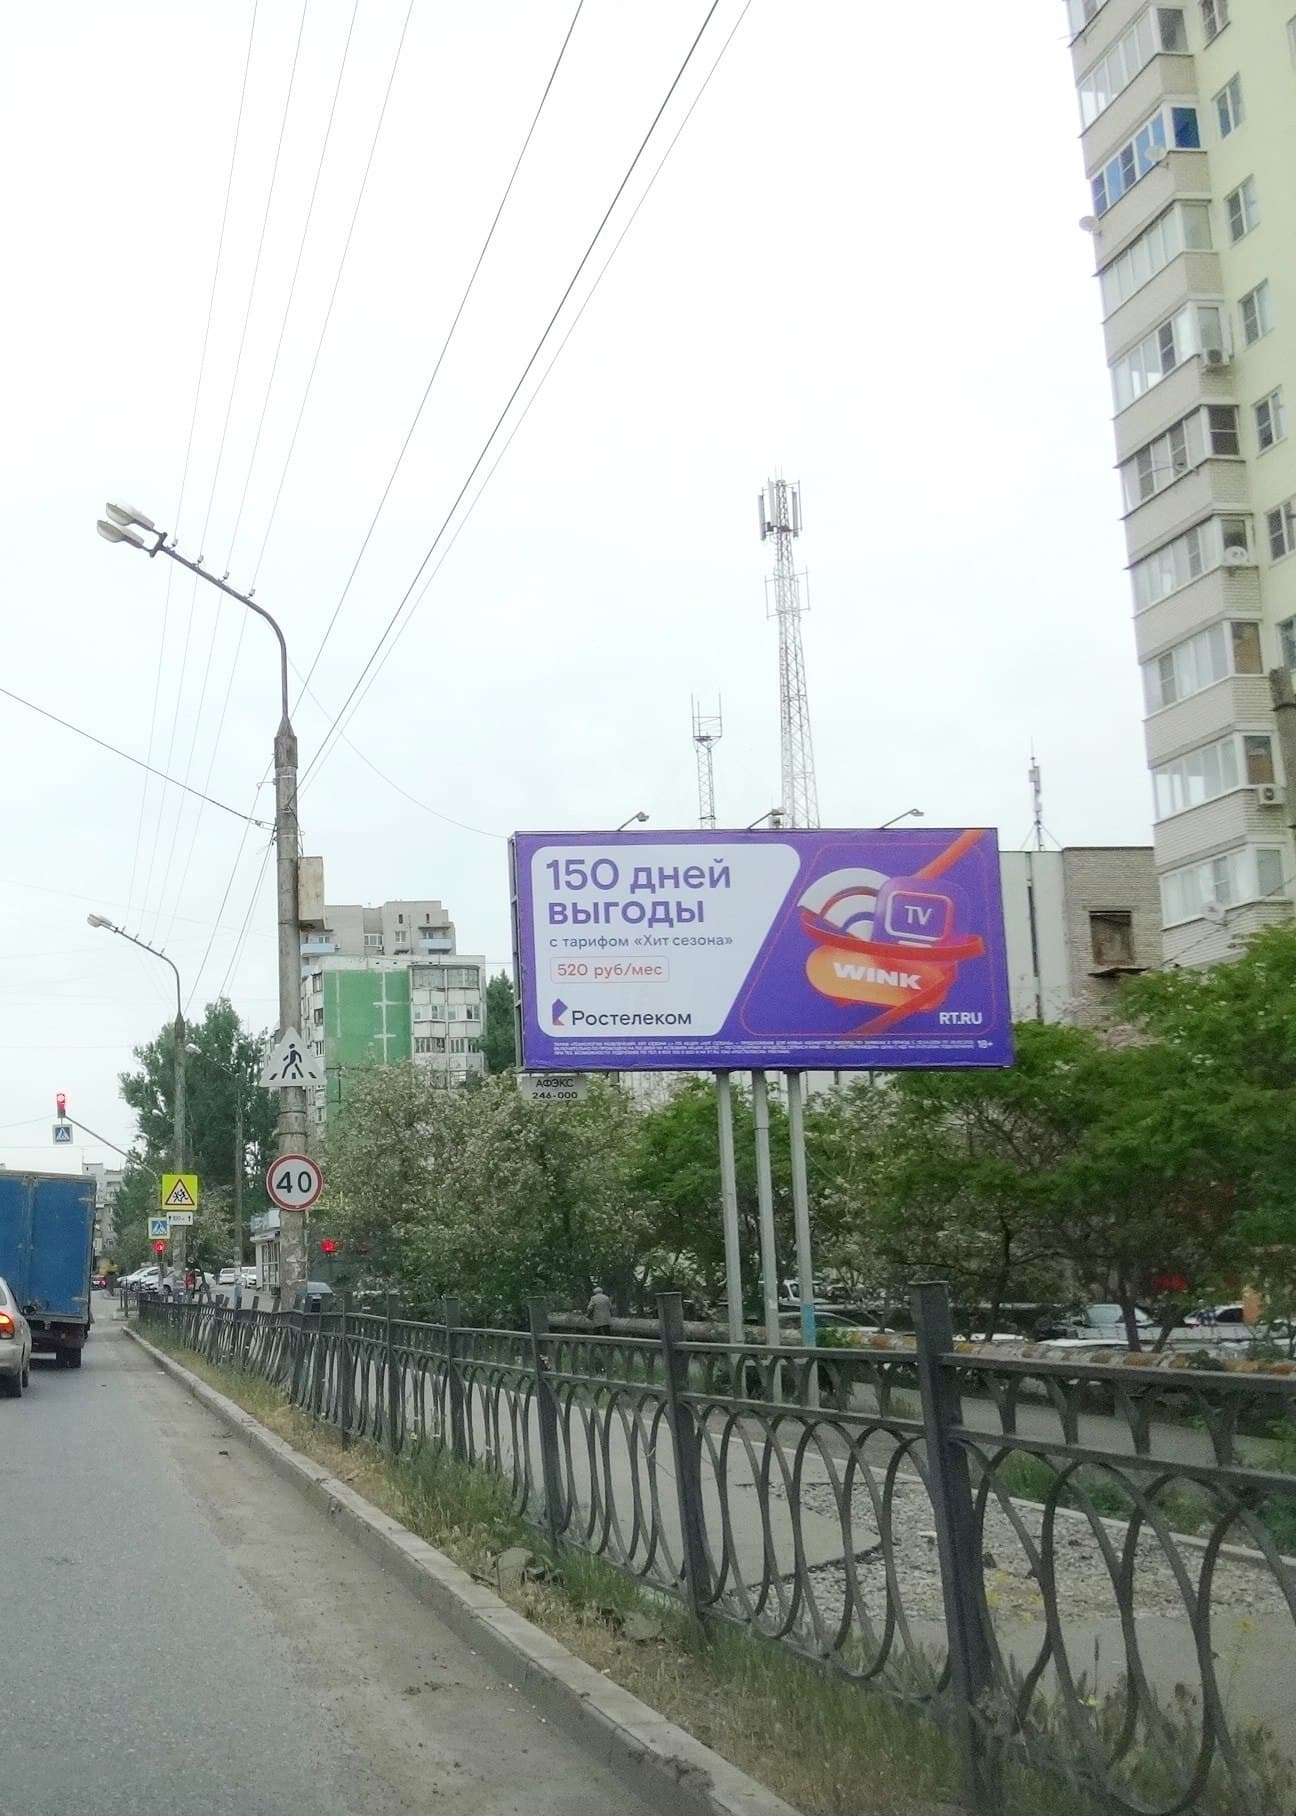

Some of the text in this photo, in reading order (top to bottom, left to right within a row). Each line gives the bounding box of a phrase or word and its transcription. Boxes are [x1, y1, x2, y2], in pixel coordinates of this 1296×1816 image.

[546, 858, 731, 894] 150 дней
[548, 900, 705, 928] выгоды
[904, 905, 933, 925] TV
[549, 935, 733, 950] с тарифом «Хит сезона»
[557, 963, 663, 979] 520 руб/мес
[833, 962, 922, 990] WINK
[572, 1010, 692, 1026] Ростелеком
[939, 1012, 983, 1025] RT.RU
[535, 1078, 575, 1088] АФЭКС
[532, 1091, 578, 1099] 246-000
[276, 1171, 312, 1193] 40
